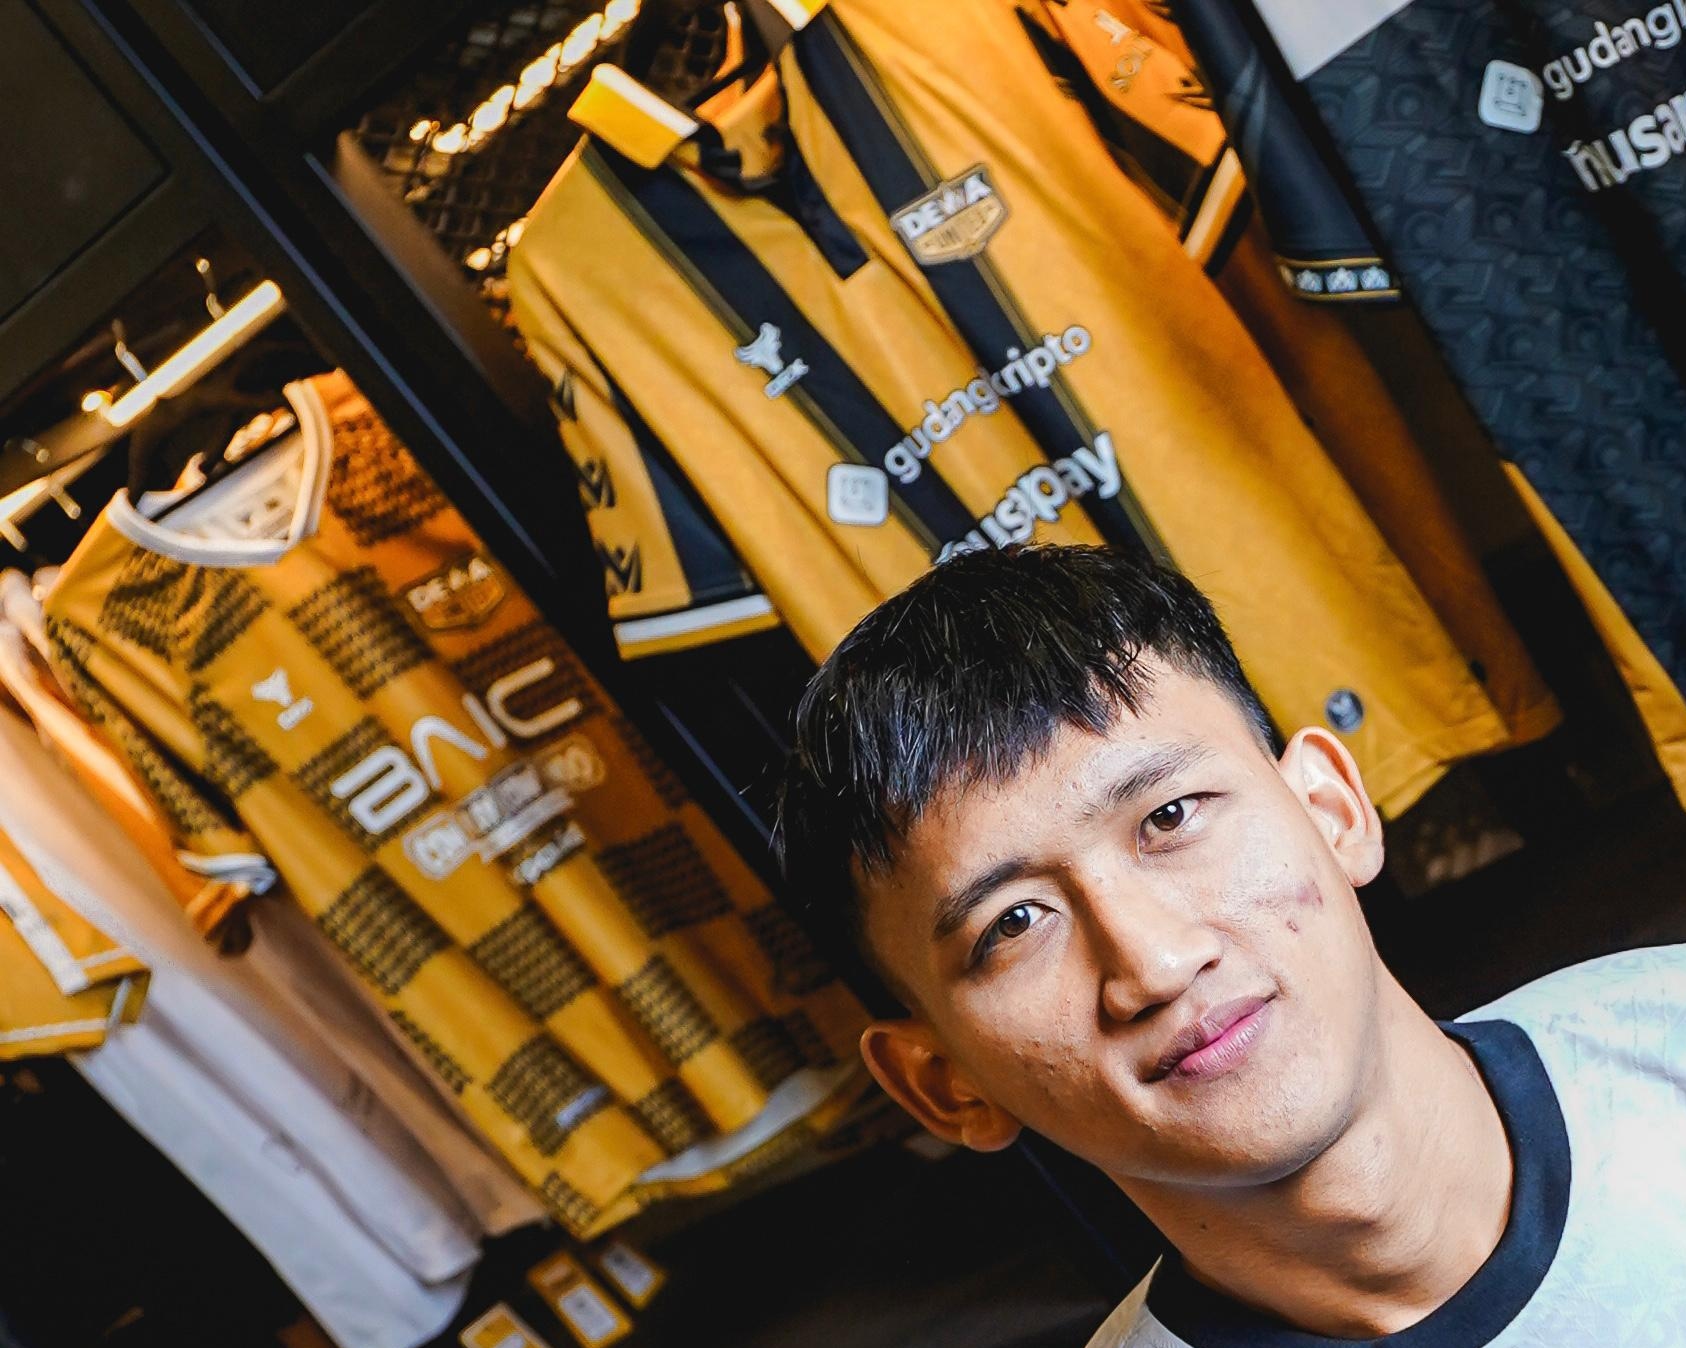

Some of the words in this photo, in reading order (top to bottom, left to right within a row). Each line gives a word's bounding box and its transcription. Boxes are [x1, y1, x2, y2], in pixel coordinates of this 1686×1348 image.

[899, 174, 993, 240] DEWA
[936, 431, 1121, 562] usapay
[329, 656, 583, 834] BAIC
